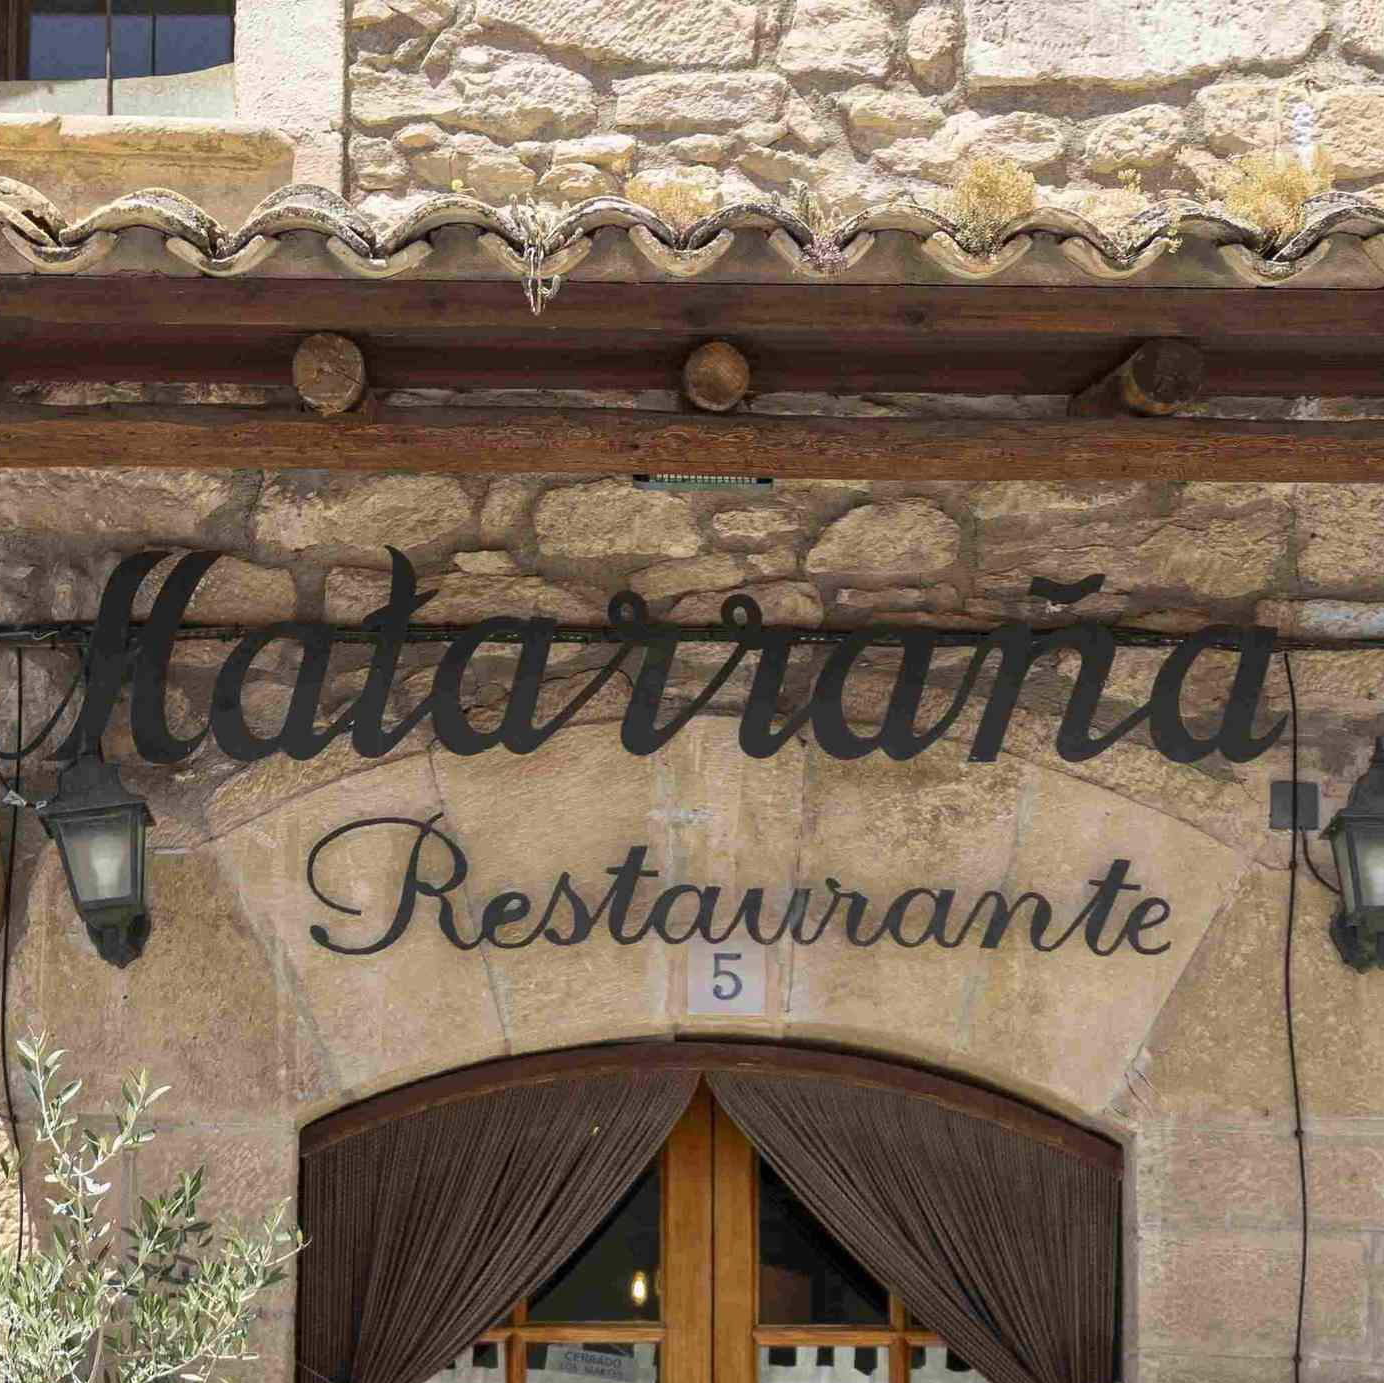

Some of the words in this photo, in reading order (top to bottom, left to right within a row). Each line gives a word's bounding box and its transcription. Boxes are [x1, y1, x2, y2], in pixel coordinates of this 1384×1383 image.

[307, 812, 1171, 955] Restaurante
[712, 952, 743, 1000] 5
[563, 1350, 622, 1368] CERRADO
